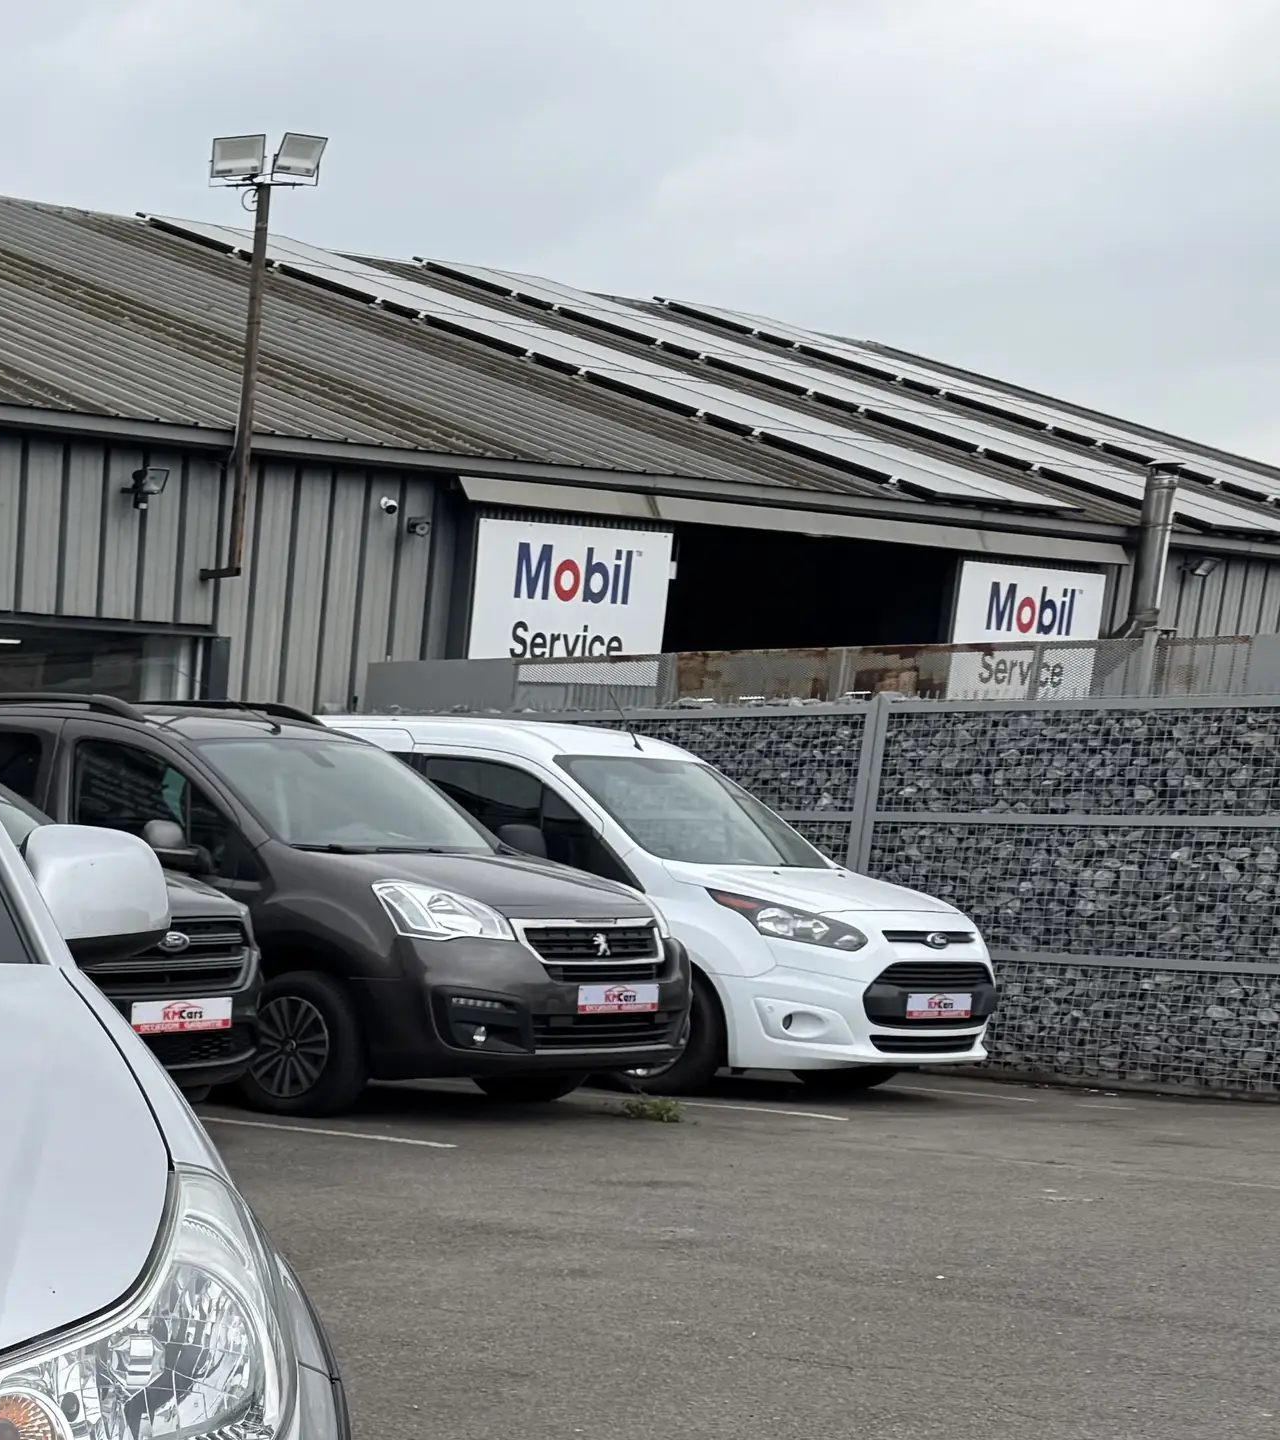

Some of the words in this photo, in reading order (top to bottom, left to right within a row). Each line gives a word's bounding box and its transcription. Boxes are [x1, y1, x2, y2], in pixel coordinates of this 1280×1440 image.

[513, 542, 634, 605] Mobil
[985, 581, 1076, 636] Mobil
[509, 620, 623, 658] Service
[978, 653, 1064, 687] Servce
